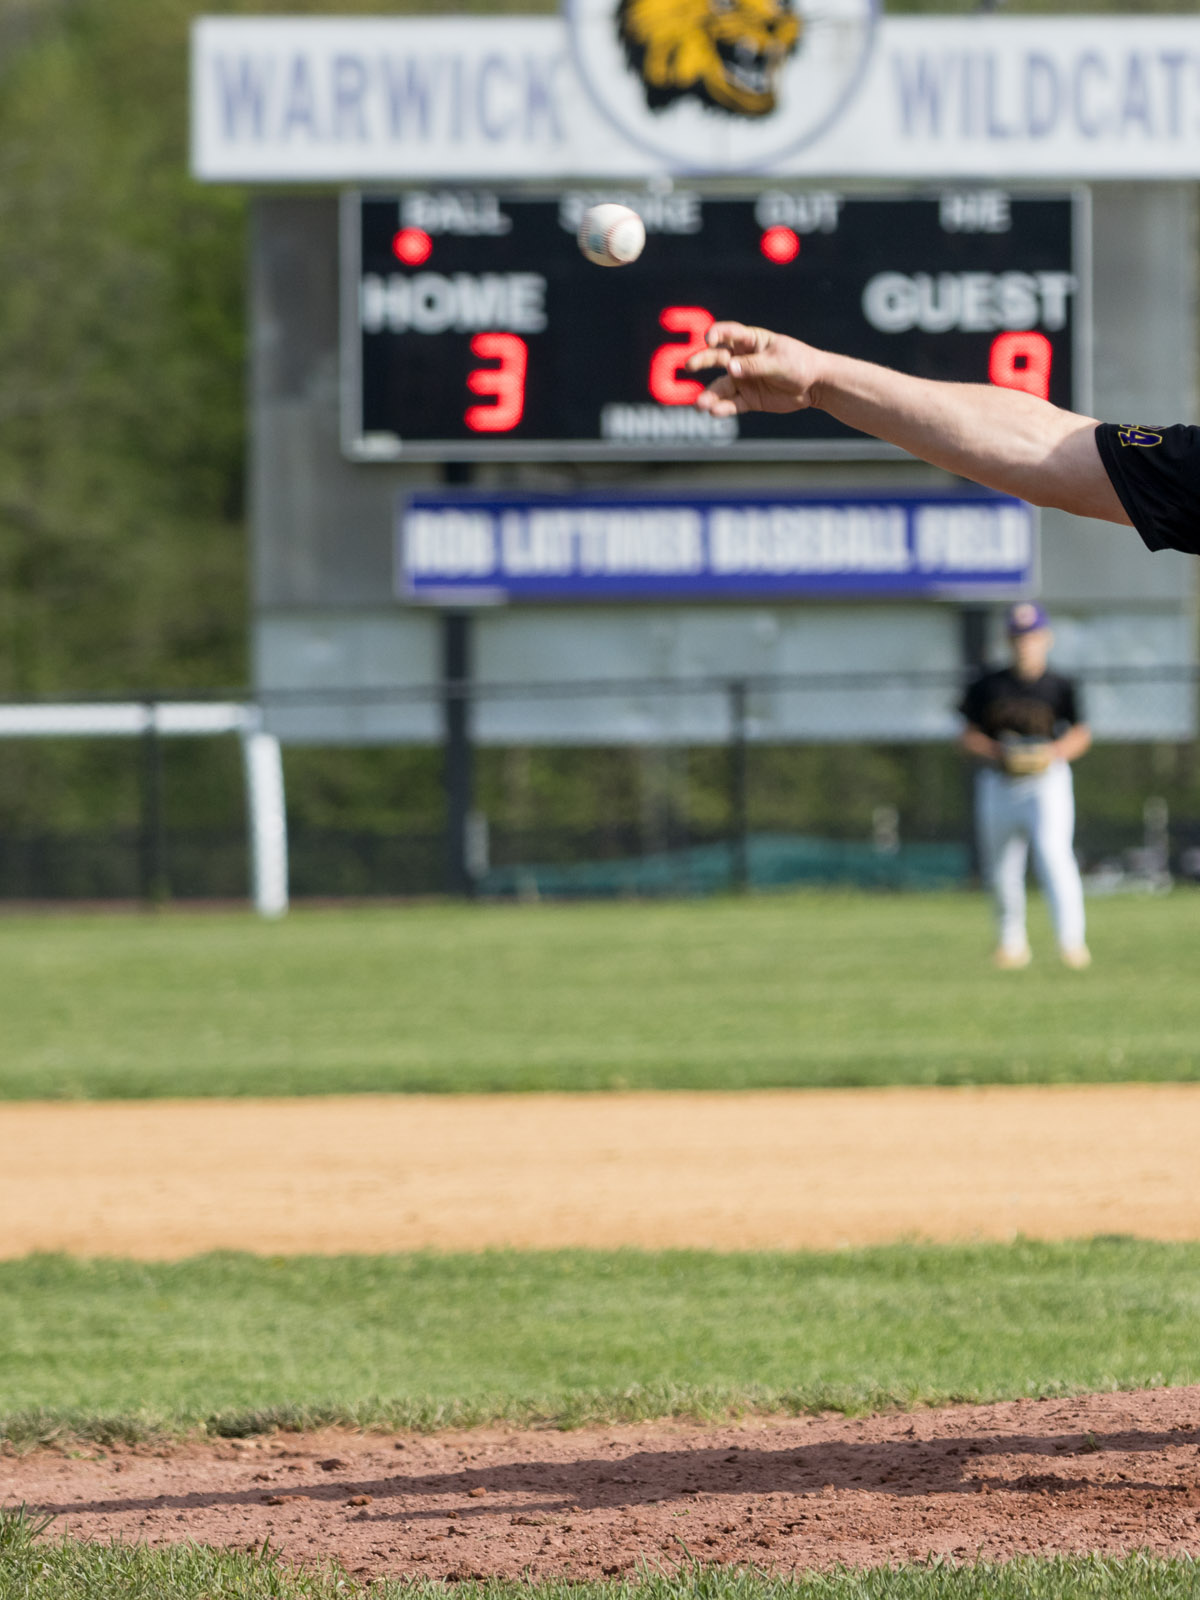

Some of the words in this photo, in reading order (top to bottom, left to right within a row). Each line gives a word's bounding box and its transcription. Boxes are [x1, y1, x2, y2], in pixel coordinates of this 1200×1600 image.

[213, 49, 568, 143] WARWICK
[399, 189, 512, 236] BALL
[754, 188, 841, 234] OUT
[361, 272, 547, 334] HOME
[861, 271, 1077, 333] GUEST
[464, 332, 528, 432] 3
[649, 305, 716, 406] 2
[706, 503, 914, 575] BASEBALL
[914, 502, 1032, 574] FIELD
